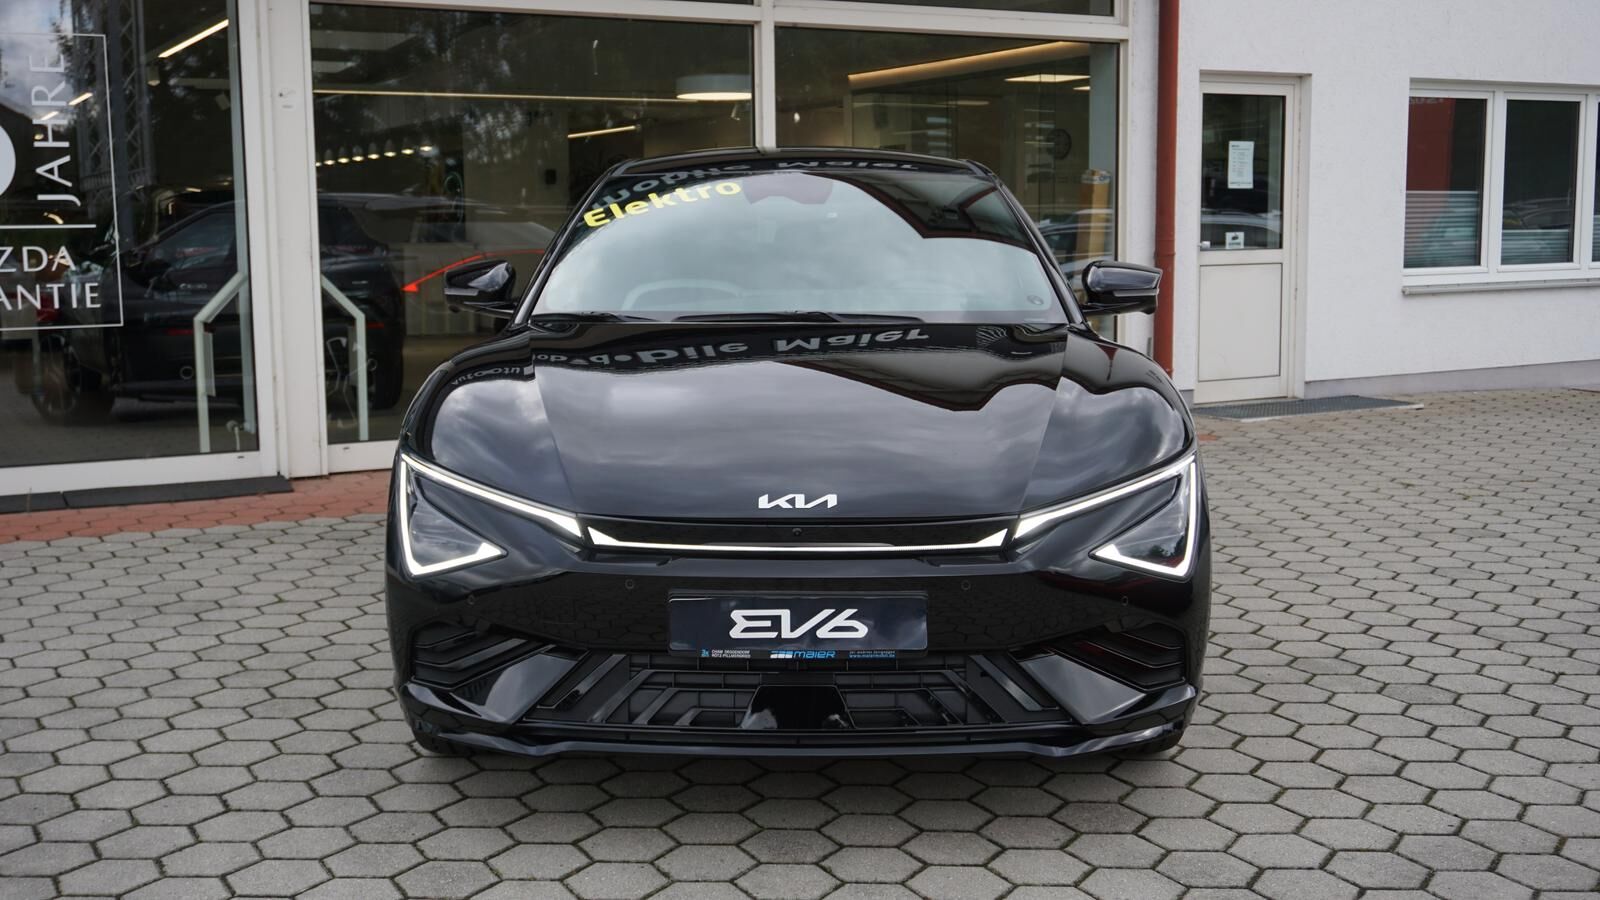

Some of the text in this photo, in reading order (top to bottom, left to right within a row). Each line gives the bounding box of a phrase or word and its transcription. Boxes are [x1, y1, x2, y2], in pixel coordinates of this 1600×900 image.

[29, 53, 81, 207] JAHRE
[583, 181, 742, 228] Elektro
[729, 608, 868, 639] EV6
